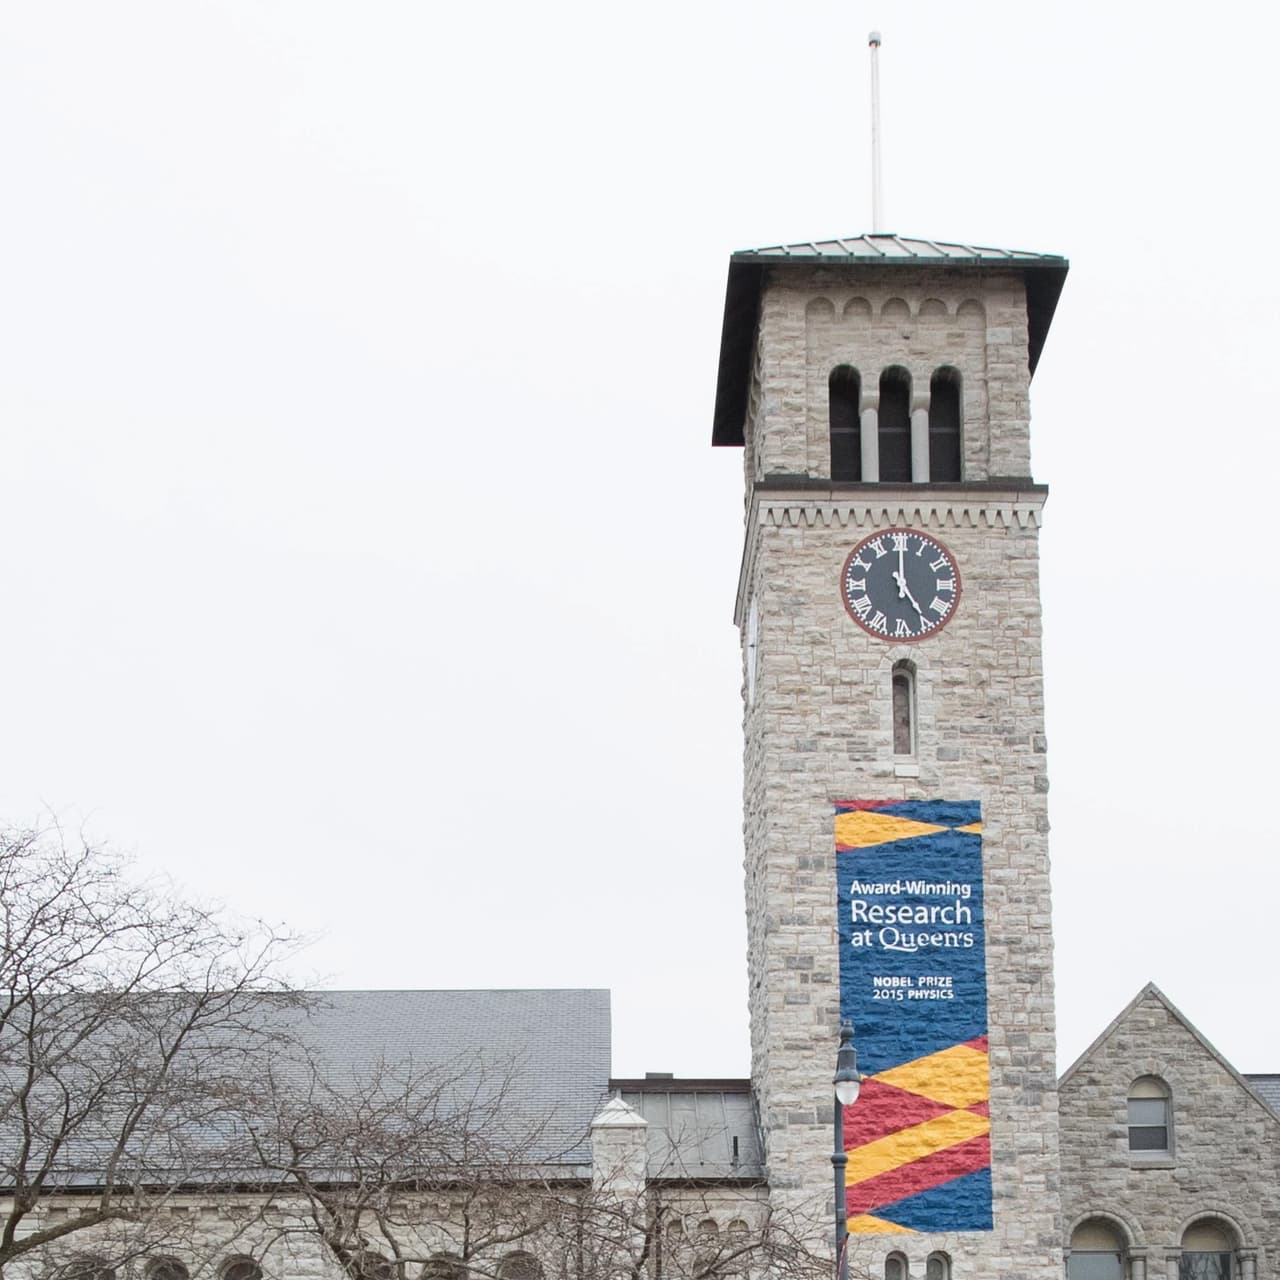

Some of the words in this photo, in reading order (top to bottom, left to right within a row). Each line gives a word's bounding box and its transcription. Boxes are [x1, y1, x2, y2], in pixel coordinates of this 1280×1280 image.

[870, 540, 887, 558] XI
[916, 541, 927, 556] I
[855, 557, 871, 571] X
[930, 557, 947, 571] II
[937, 579, 953, 590] III
[852, 595, 872, 619] VIII
[870, 611, 887, 632] VII
[896, 619, 912, 634] VI
[920, 616, 933, 630] V
[850, 880, 971, 899] Award-Winning
[851, 900, 971, 924] Research
[851, 930, 873, 947] at
[879, 927, 974, 952] Queen's
[873, 976, 914, 987] NOBEL
[918, 976, 953, 987] PRIZE
[873, 989, 904, 1000] 2015
[908, 990, 954, 1000] PHYSICS
